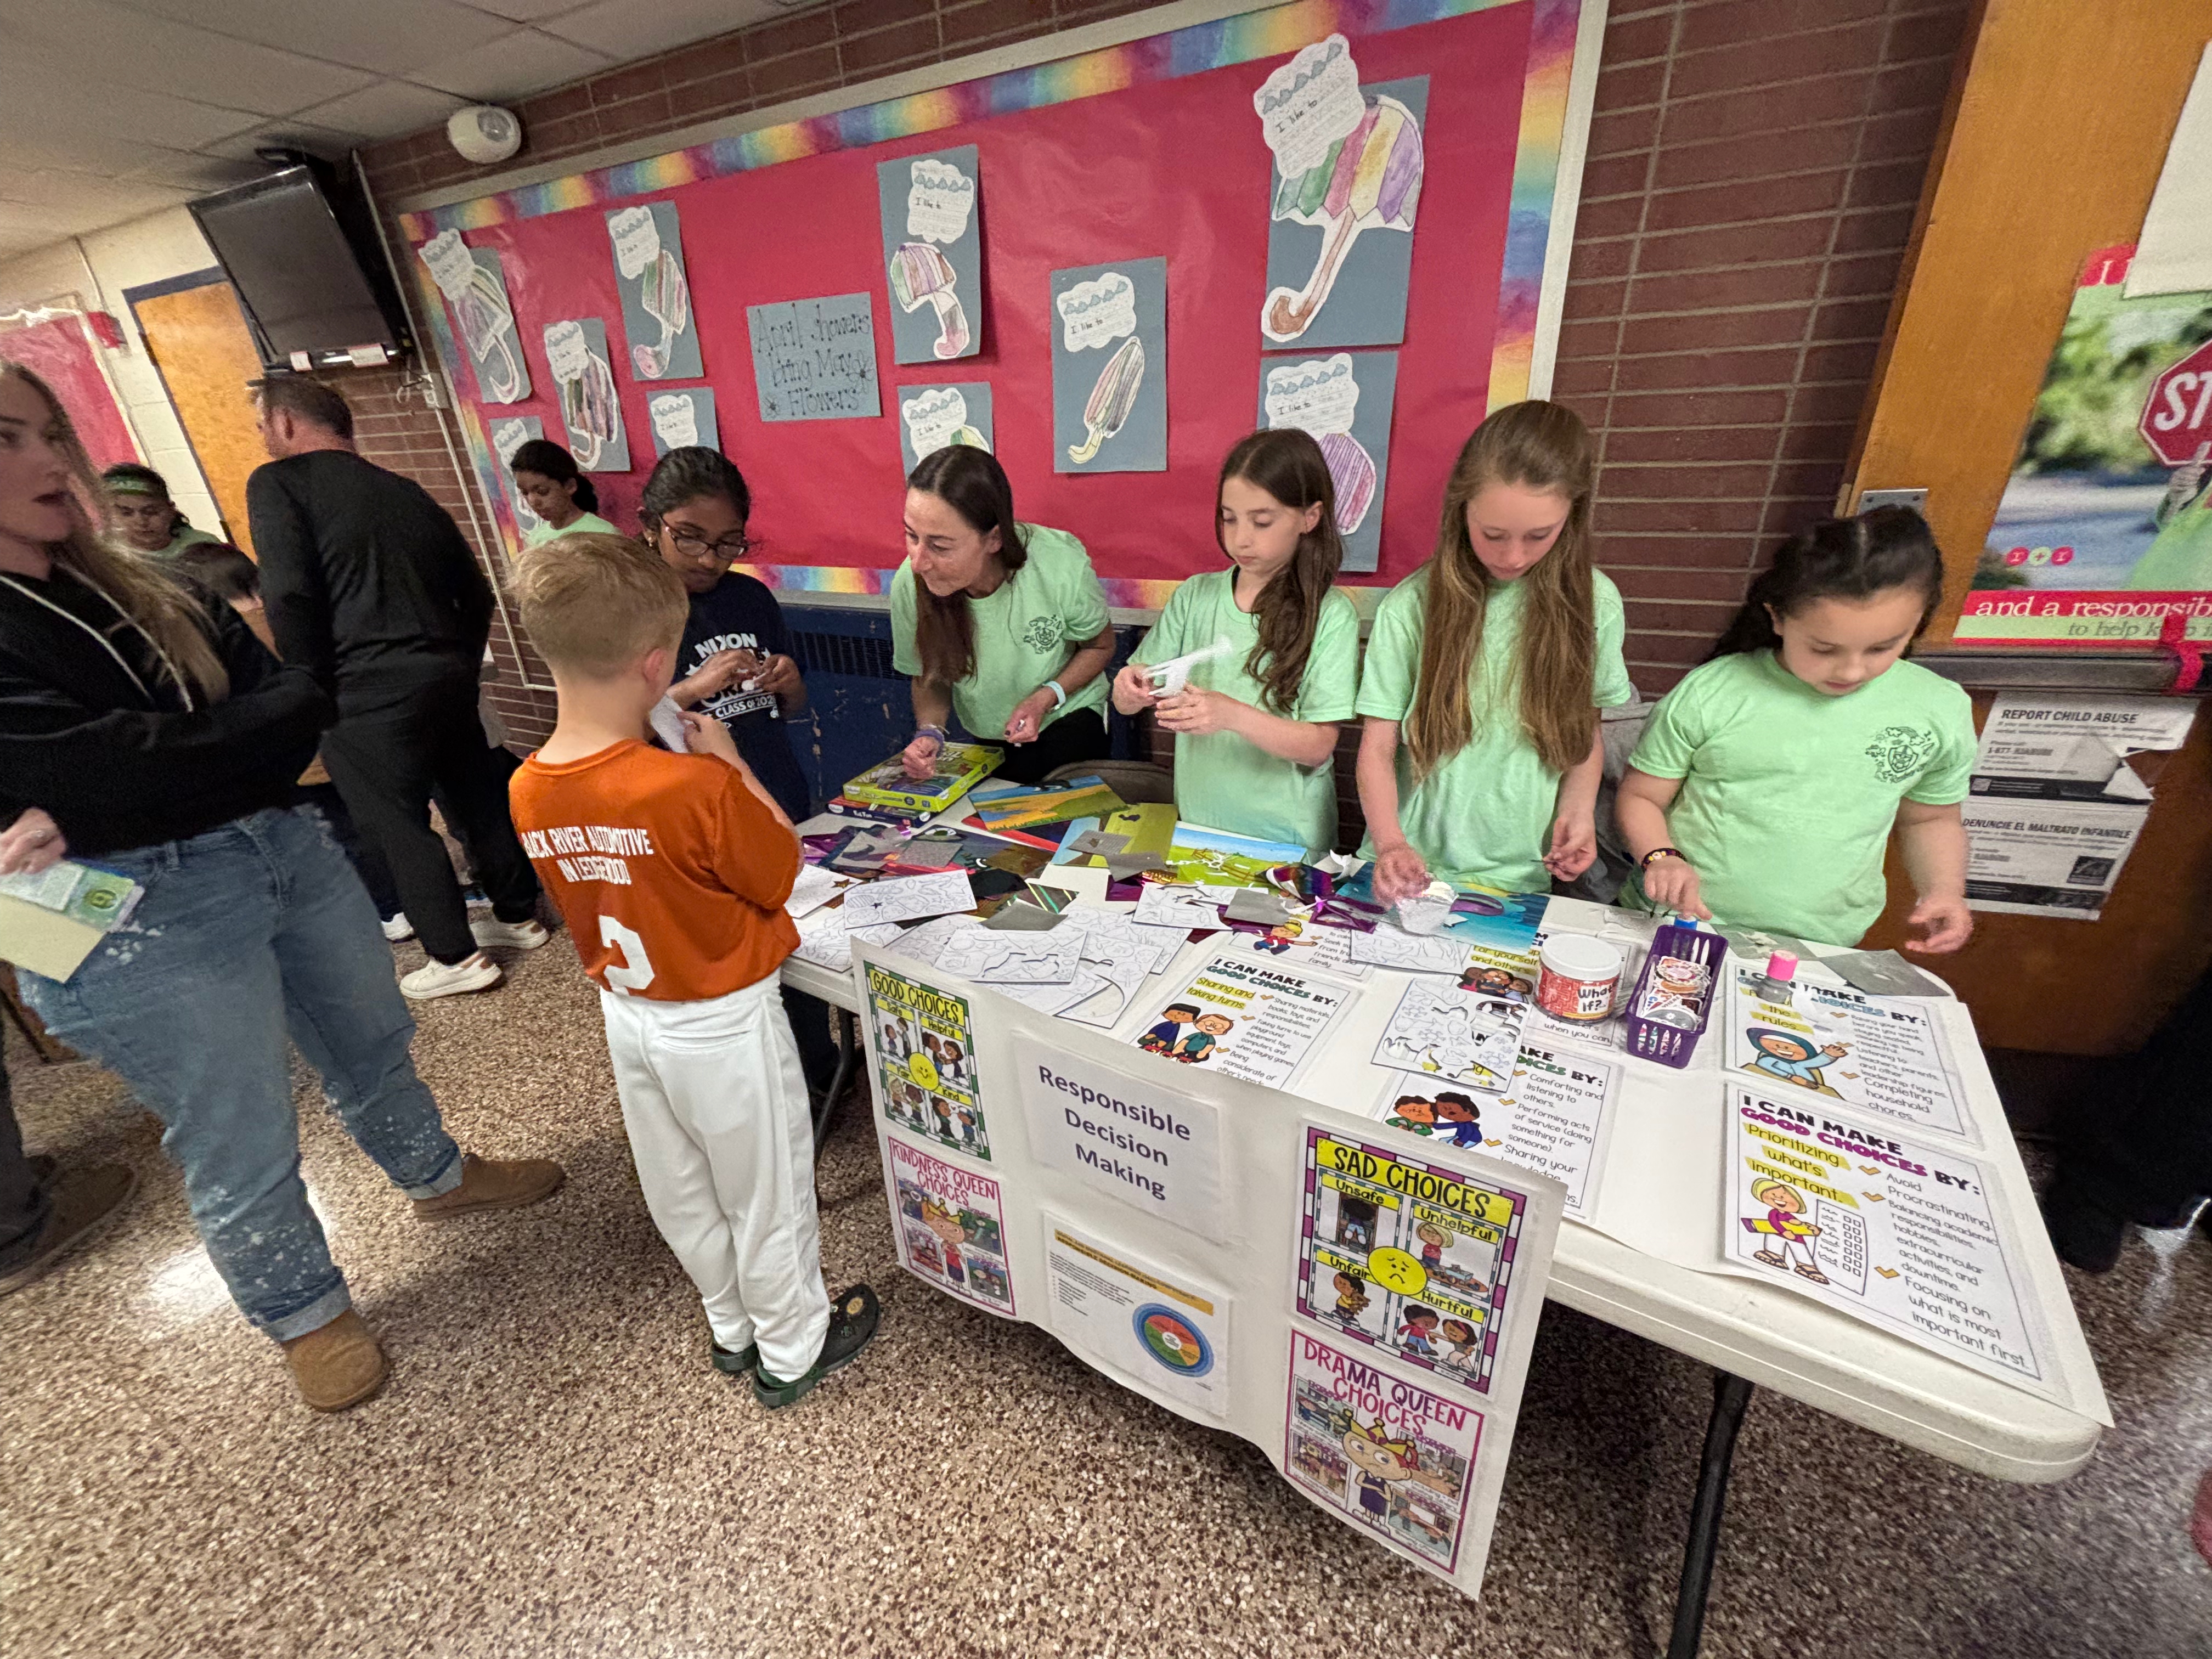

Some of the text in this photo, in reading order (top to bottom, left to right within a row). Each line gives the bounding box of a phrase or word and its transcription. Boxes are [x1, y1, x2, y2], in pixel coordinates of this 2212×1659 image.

[1289, 100, 1318, 124] like to
[757, 302, 803, 364] April
[1081, 321, 1093, 331] like
[815, 348, 852, 379] May
[1976, 596, 2060, 617] and a
[2068, 620, 2138, 640] to help
[695, 633, 758, 659] NIXON
[715, 701, 747, 718] CLASS
[2001, 709, 2140, 724] REPORT CHILD ABUSE
[547, 826, 590, 855] RIVER
[2014, 822, 2025, 831] EL
[2028, 823, 2080, 834] MALTRATO
[2081, 827, 2132, 839] INFANTILE
[1318, 944, 1338, 953] from
[1324, 937, 1340, 946] Seek
[1313, 951, 1341, 962] friends
[1471, 955, 1492, 965] and
[1206, 966, 1339, 1008] GOOD CHOICES BY:
[1223, 961, 1258, 975] CAN
[1259, 970, 1306, 989] MAKE
[873, 972, 960, 1024] GOOD CHOICES
[1186, 986, 1216, 1002] taking
[1197, 977, 1257, 1000] Sharing and
[1577, 984, 1614, 999] What
[887, 1002, 902, 1016] Safe
[1273, 997, 1298, 1009] Sharing
[1769, 1005, 1791, 1018] the
[928, 1020, 955, 1038] Helpful
[1257, 1018, 1276, 1029] Taking
[1277, 1023, 1292, 1034] turns
[1305, 1015, 1321, 1024] and
[1891, 1011, 1927, 1026] BY:
[1250, 1024, 1285, 1039] playground
[1544, 1023, 1569, 1035] when
[1571, 1030, 1589, 1040] you
[1229, 1051, 1250, 1063] Being
[1235, 1043, 1252, 1053] when
[1252, 1048, 1274, 1060] playing
[1273, 1047, 1287, 1056] and
[1855, 1046, 1896, 1062] Listening
[1223, 1059, 1278, 1081] considerate of
[1571, 1070, 1604, 1087] BY:
[1859, 1062, 1903, 1077] and other
[1860, 1069, 1909, 1087] leadership
[942, 1087, 960, 1101] Kind
[1526, 1082, 1577, 1104] listening to
[1530, 1074, 1604, 1101] Comforting and
[1864, 1077, 1933, 1105] Completing
[1038, 1064, 1190, 1141] Responsible
[1865, 1088, 1931, 1113] household
[1514, 1114, 1593, 1144] of service (doing
[1517, 1103, 1590, 1132] Performing acts
[1743, 1096, 1904, 1156] I CAN MAKE
[1064, 1107, 1169, 1167] Decision
[1508, 1132, 1554, 1153] someone).
[1511, 1122, 1576, 1148] something for
[1748, 1123, 1840, 1168] Prioritizing
[1504, 1144, 1547, 1166] Sharing
[1550, 1160, 1578, 1173] your
[1740, 1107, 1980, 1195] GOOD CHOICES BY:
[1768, 1147, 1822, 1177] what's
[893, 1144, 948, 1182] KINDNESS
[952, 1171, 996, 1200] QUEEN
[1075, 1143, 1166, 1201] Making
[1334, 1147, 1378, 1179] SAD
[1386, 1164, 1491, 1218] CHOICES
[1752, 1159, 1844, 1204] important.
[1886, 1173, 1922, 1192] Avoid
[917, 1170, 970, 1207] CHOICES
[1336, 1178, 1385, 1205] Unsafe
[1420, 1207, 1493, 1242] Unhelpful
[1888, 1199, 2000, 1247] Balancing academic
[1896, 1236, 1984, 1274] extracurricular
[1330, 1256, 1371, 1280] Unfair
[1900, 1261, 1962, 1293] downtime.
[1955, 1271, 1979, 1286] and
[1421, 1290, 1474, 1319] Hurtful
[1904, 1275, 1992, 1320] Focusing on
[1908, 1294, 2002, 1341] what is most
[1911, 1310, 1985, 1351] important
[1304, 1341, 1467, 1431] DRAMA QUEEN
[1333, 1376, 1427, 1436] CHOICES
